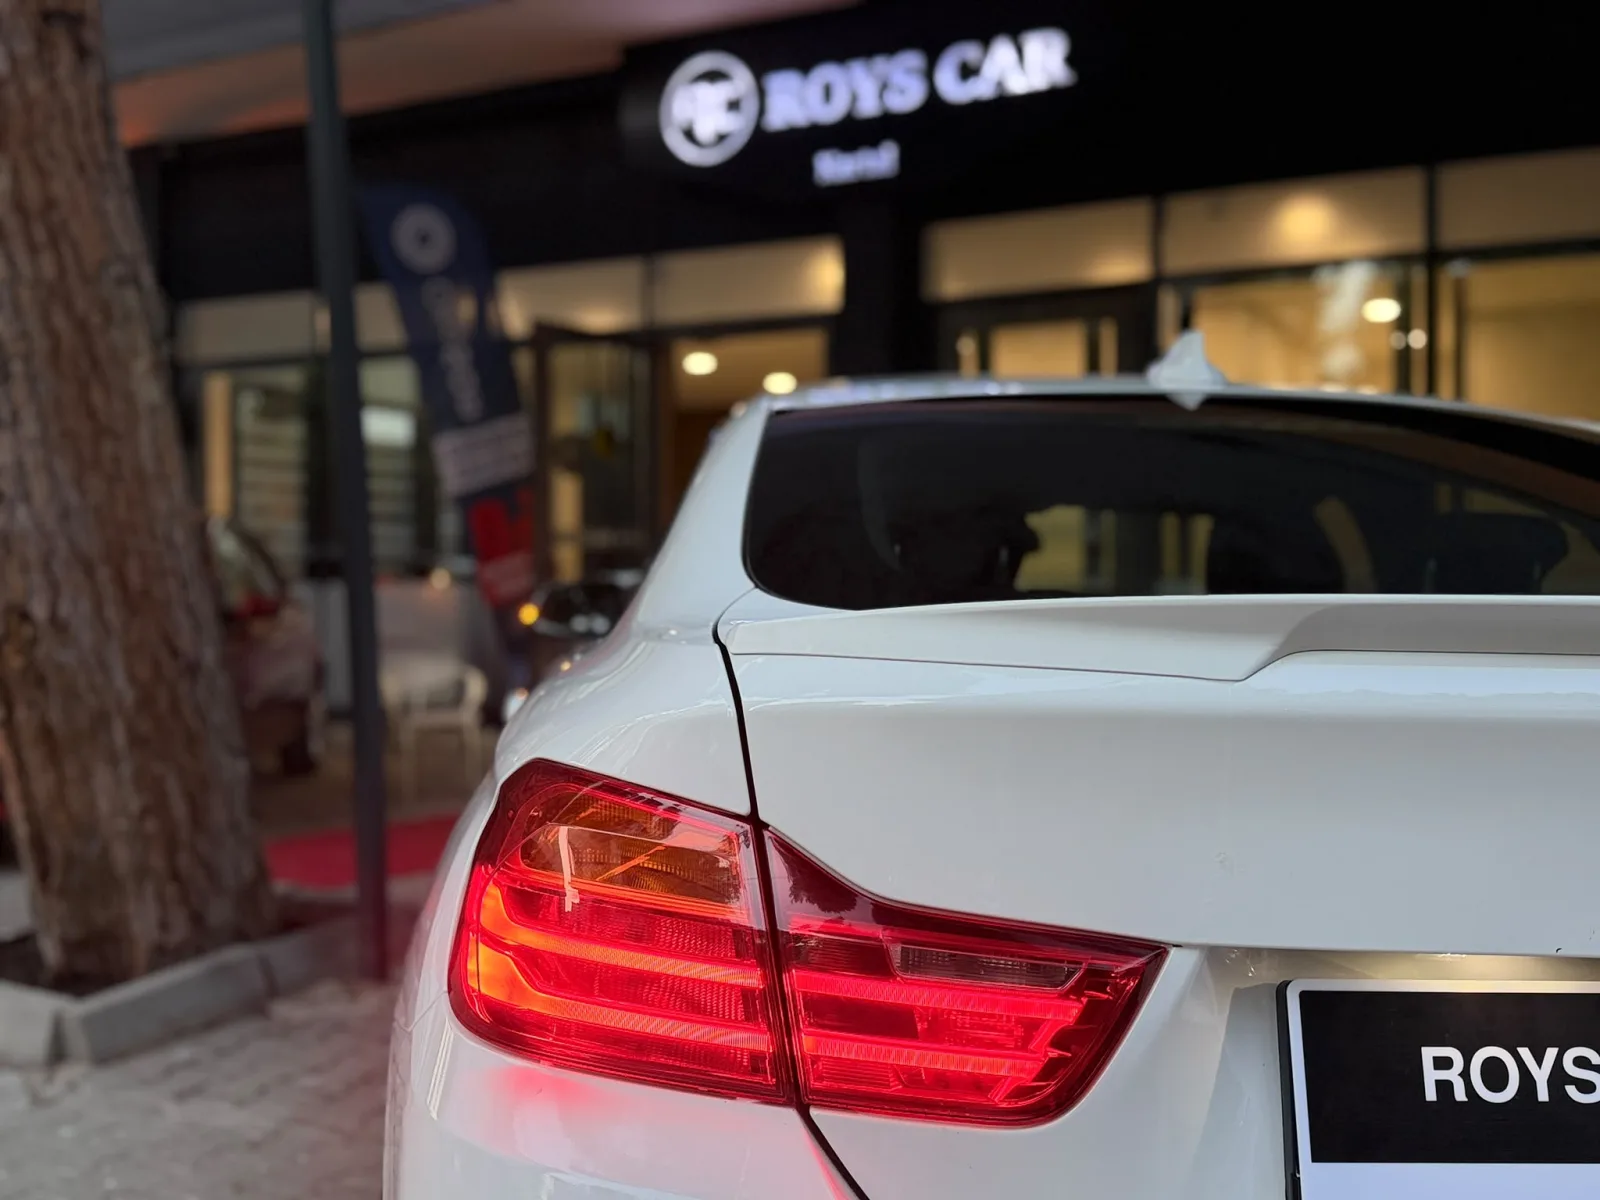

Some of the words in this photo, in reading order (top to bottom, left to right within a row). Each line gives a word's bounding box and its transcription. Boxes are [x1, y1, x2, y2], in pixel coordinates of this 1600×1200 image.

[761, 49, 929, 132] ROYS
[933, 27, 1075, 105] CAR
[1421, 1045, 1600, 1104] ROYS
